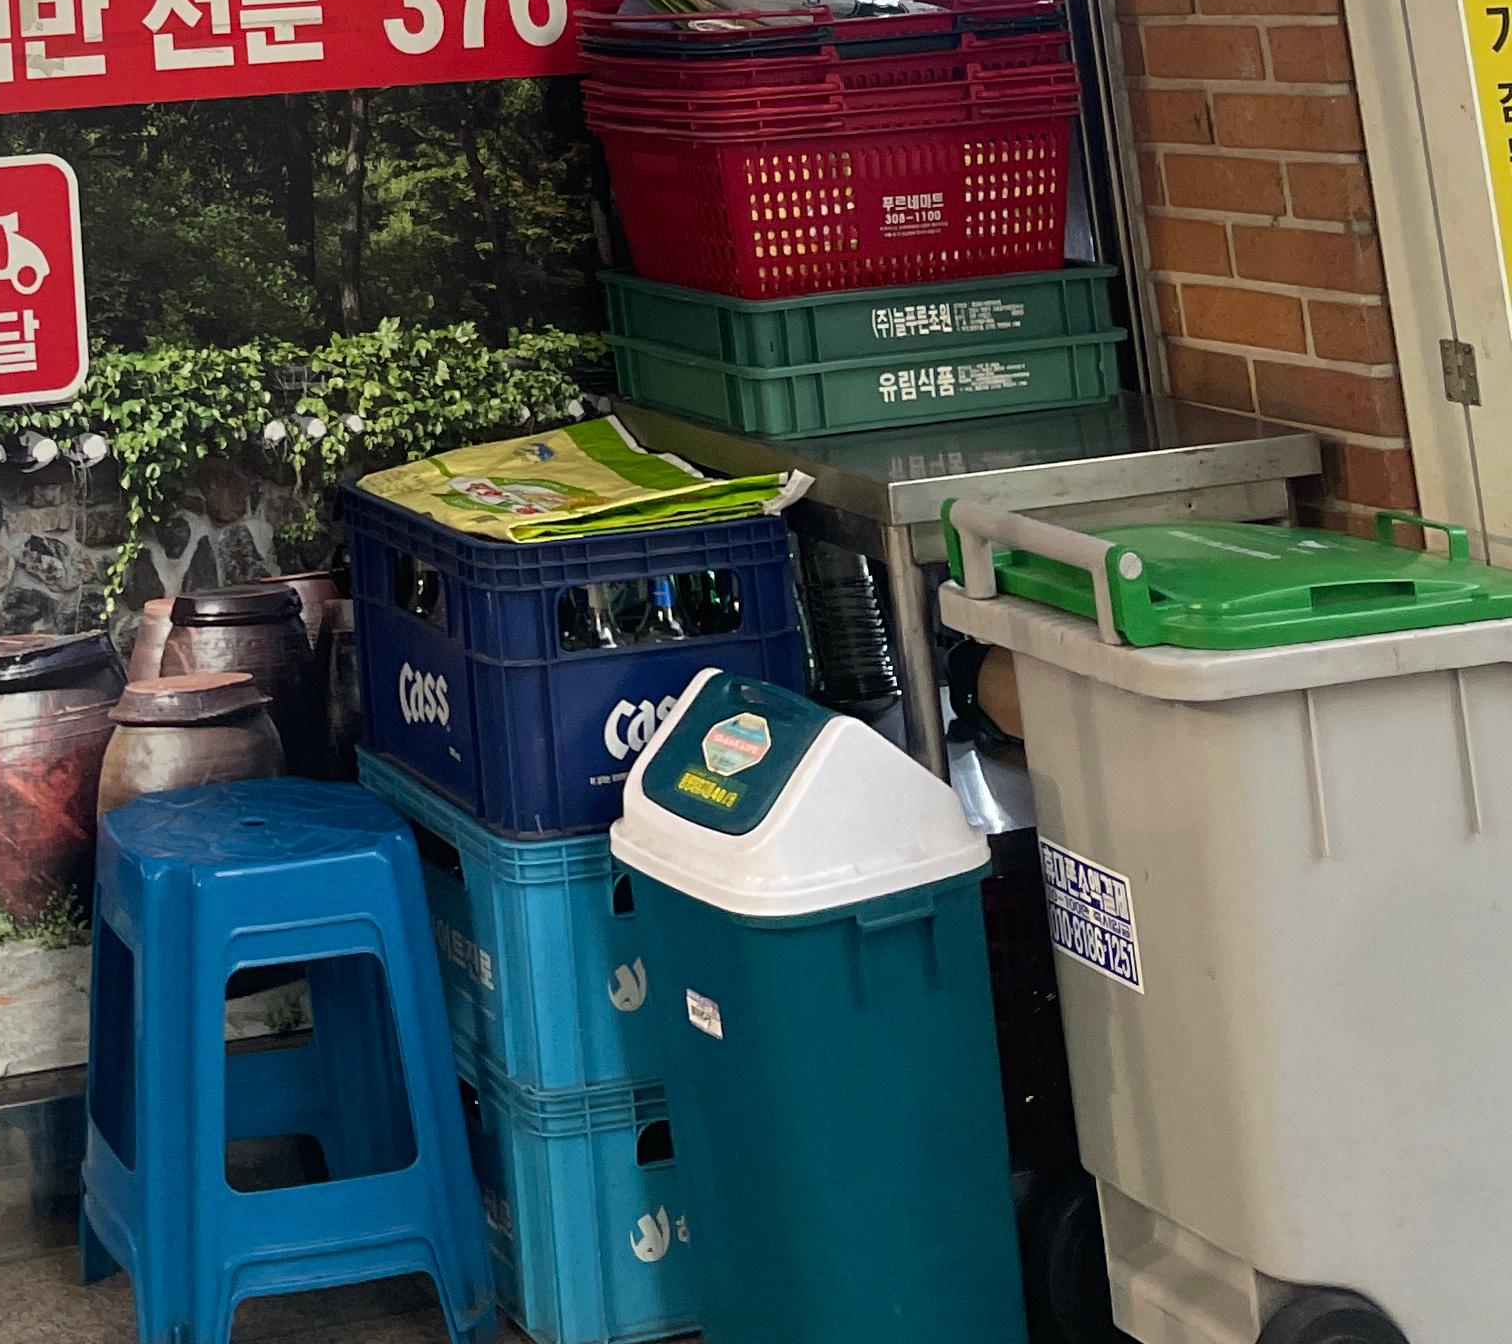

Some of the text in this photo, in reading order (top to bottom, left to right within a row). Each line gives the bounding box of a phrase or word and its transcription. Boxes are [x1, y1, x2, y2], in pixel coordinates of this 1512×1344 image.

[882, 192, 944, 212] 푸르네마트
[879, 365, 956, 403] 유림식품
[399, 661, 450, 727] Cass
